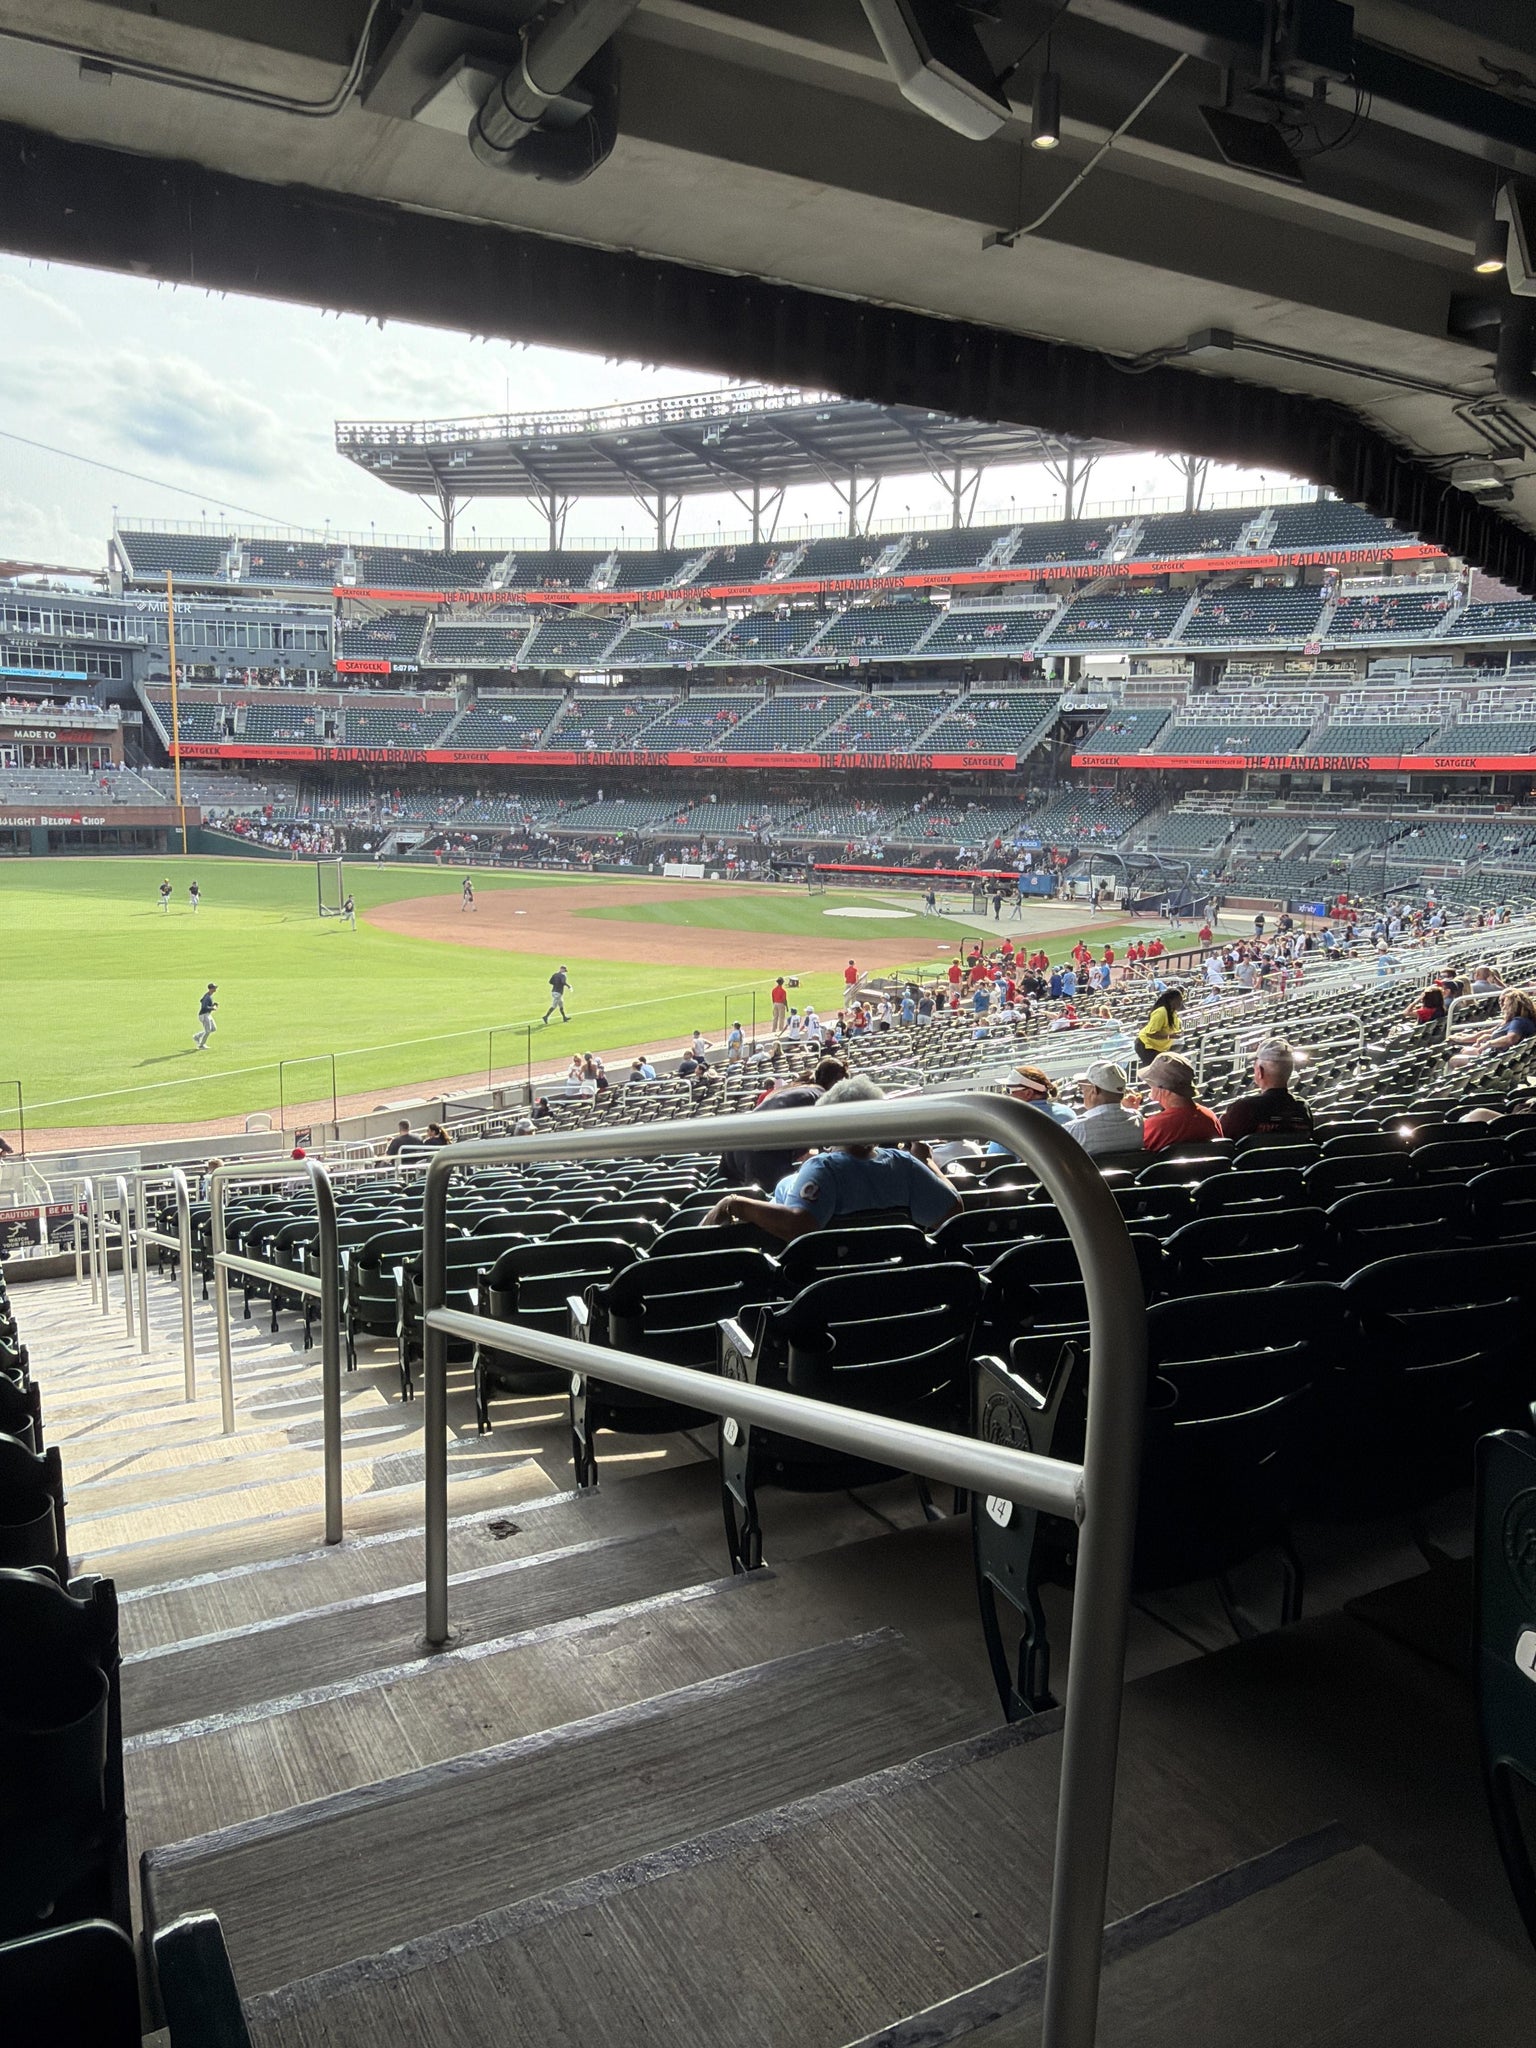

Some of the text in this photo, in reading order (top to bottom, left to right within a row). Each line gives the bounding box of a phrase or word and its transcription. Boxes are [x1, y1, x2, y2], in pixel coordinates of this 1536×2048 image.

[1278, 548, 1393, 566] THE ATLANTA BRAVES
[1031, 568, 1048, 581] THE
[1048, 565, 1090, 580] ATLANTA
[1092, 563, 1129, 578] BRAVES
[1152, 562, 1185, 571] SEATGEEK
[820, 581, 835, 592] THE
[835, 577, 871, 591] ATLANTA
[873, 576, 904, 589] BRAVES
[444, 592, 458, 602] THE
[459, 592, 495, 602] ATLANTA
[496, 592, 526, 602] BRAVES
[637, 591, 650, 602] THE
[650, 589, 684, 601] ATLANTA
[684, 588, 711, 599] BRAVES
[148, 602, 191, 614] MILNER
[1304, 642, 1321, 655] 25
[346, 662, 382, 671] SEATGEEK
[14, 730, 41, 739] MADE
[44, 731, 57, 739] TO
[180, 746, 221, 755] SEATGEEK
[316, 748, 336, 761] THE
[337, 748, 385, 762] ATLANTA
[388, 749, 427, 763] BRAVES
[454, 753, 490, 761] SEATGEEK
[576, 752, 591, 765] THE
[592, 752, 631, 765] ATLANTA
[634, 752, 669, 766] BRAVES
[694, 755, 728, 764] SEATGEEK
[819, 754, 839, 768] THE
[840, 754, 886, 769] ATLANTA
[891, 755, 932, 769] BRAVES
[963, 757, 1005, 767] SEATGEEK
[1082, 757, 1120, 766] SEATGEEK
[1435, 758, 1476, 768] SEATGEEK
[1246, 757, 1369, 770] THE ATLANTA BRAVES
[41, 816, 72, 826] BELOW
[81, 816, 106, 826] CHOP
[0, 1209, 35, 1220] CAUTION
[49, 1203, 86, 1215] BE ALET
[726, 1421, 736, 1440] 13
[991, 1497, 1006, 1519] 14
